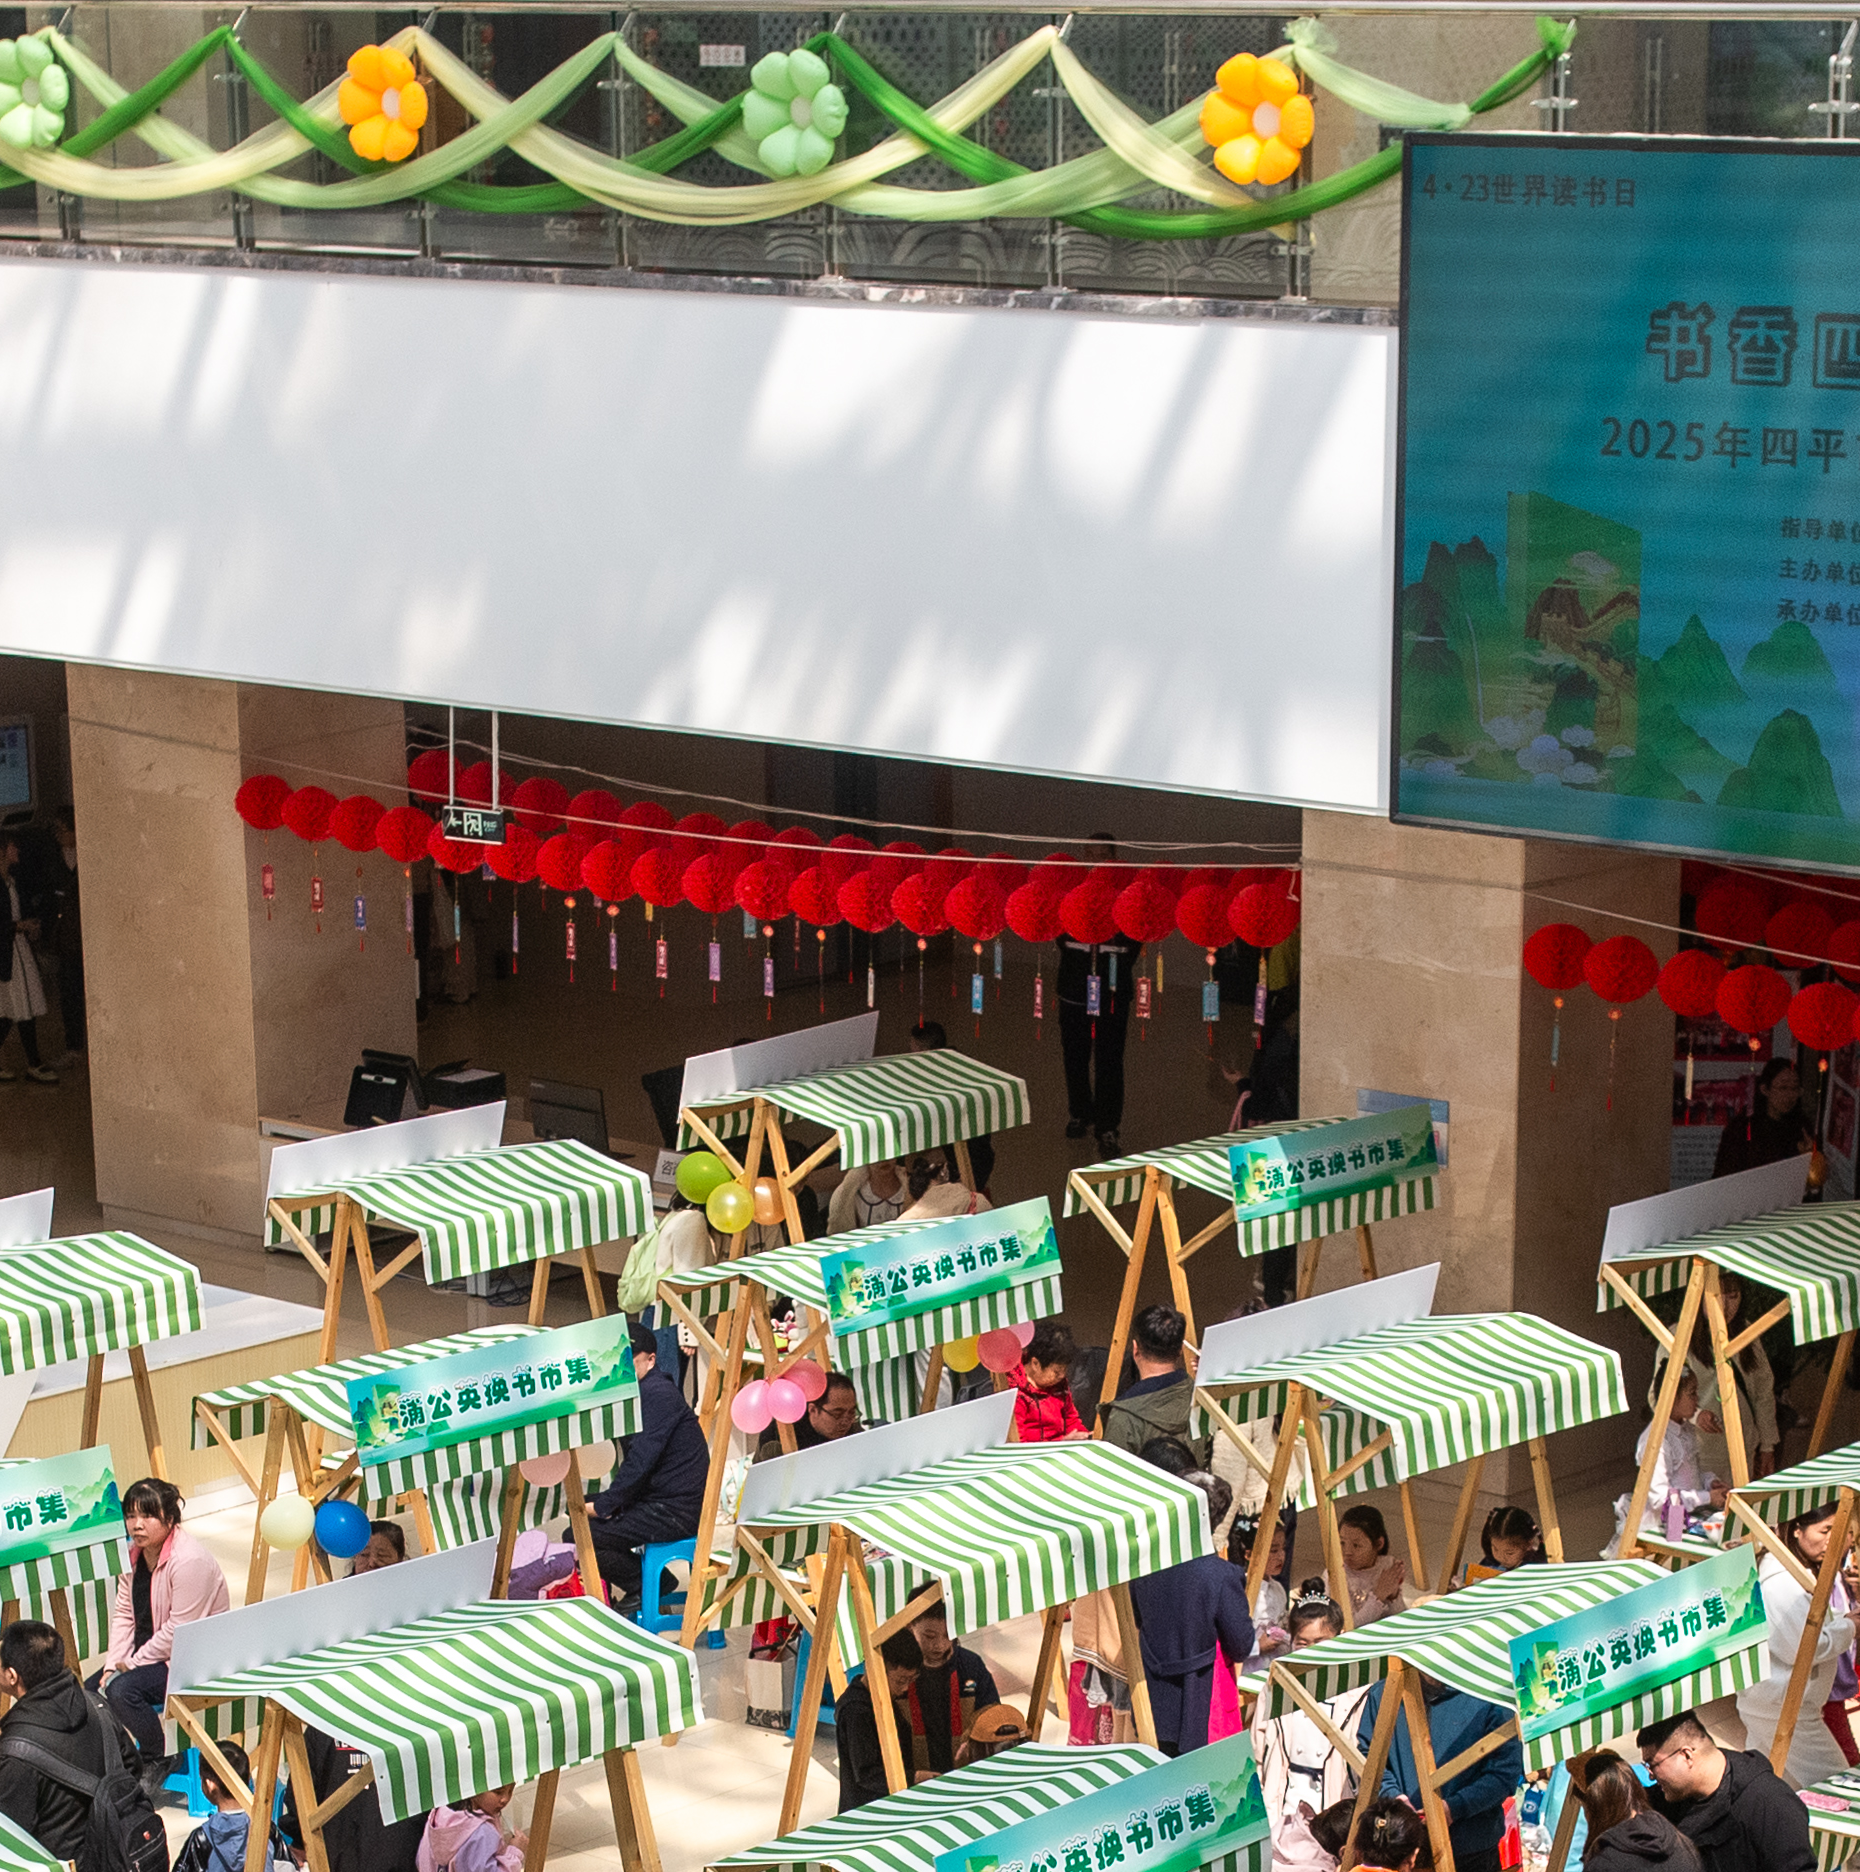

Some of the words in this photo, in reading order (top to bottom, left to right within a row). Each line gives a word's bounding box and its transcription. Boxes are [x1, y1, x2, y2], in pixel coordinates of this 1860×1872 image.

[1265, 1132, 1406, 1190] 蒲公英换书市集
[862, 1231, 1023, 1301] 蒲公英换书市集
[397, 1351, 592, 1429] 蒲公英换书市集
[1555, 1589, 1728, 1692] 蒲公英换书市集
